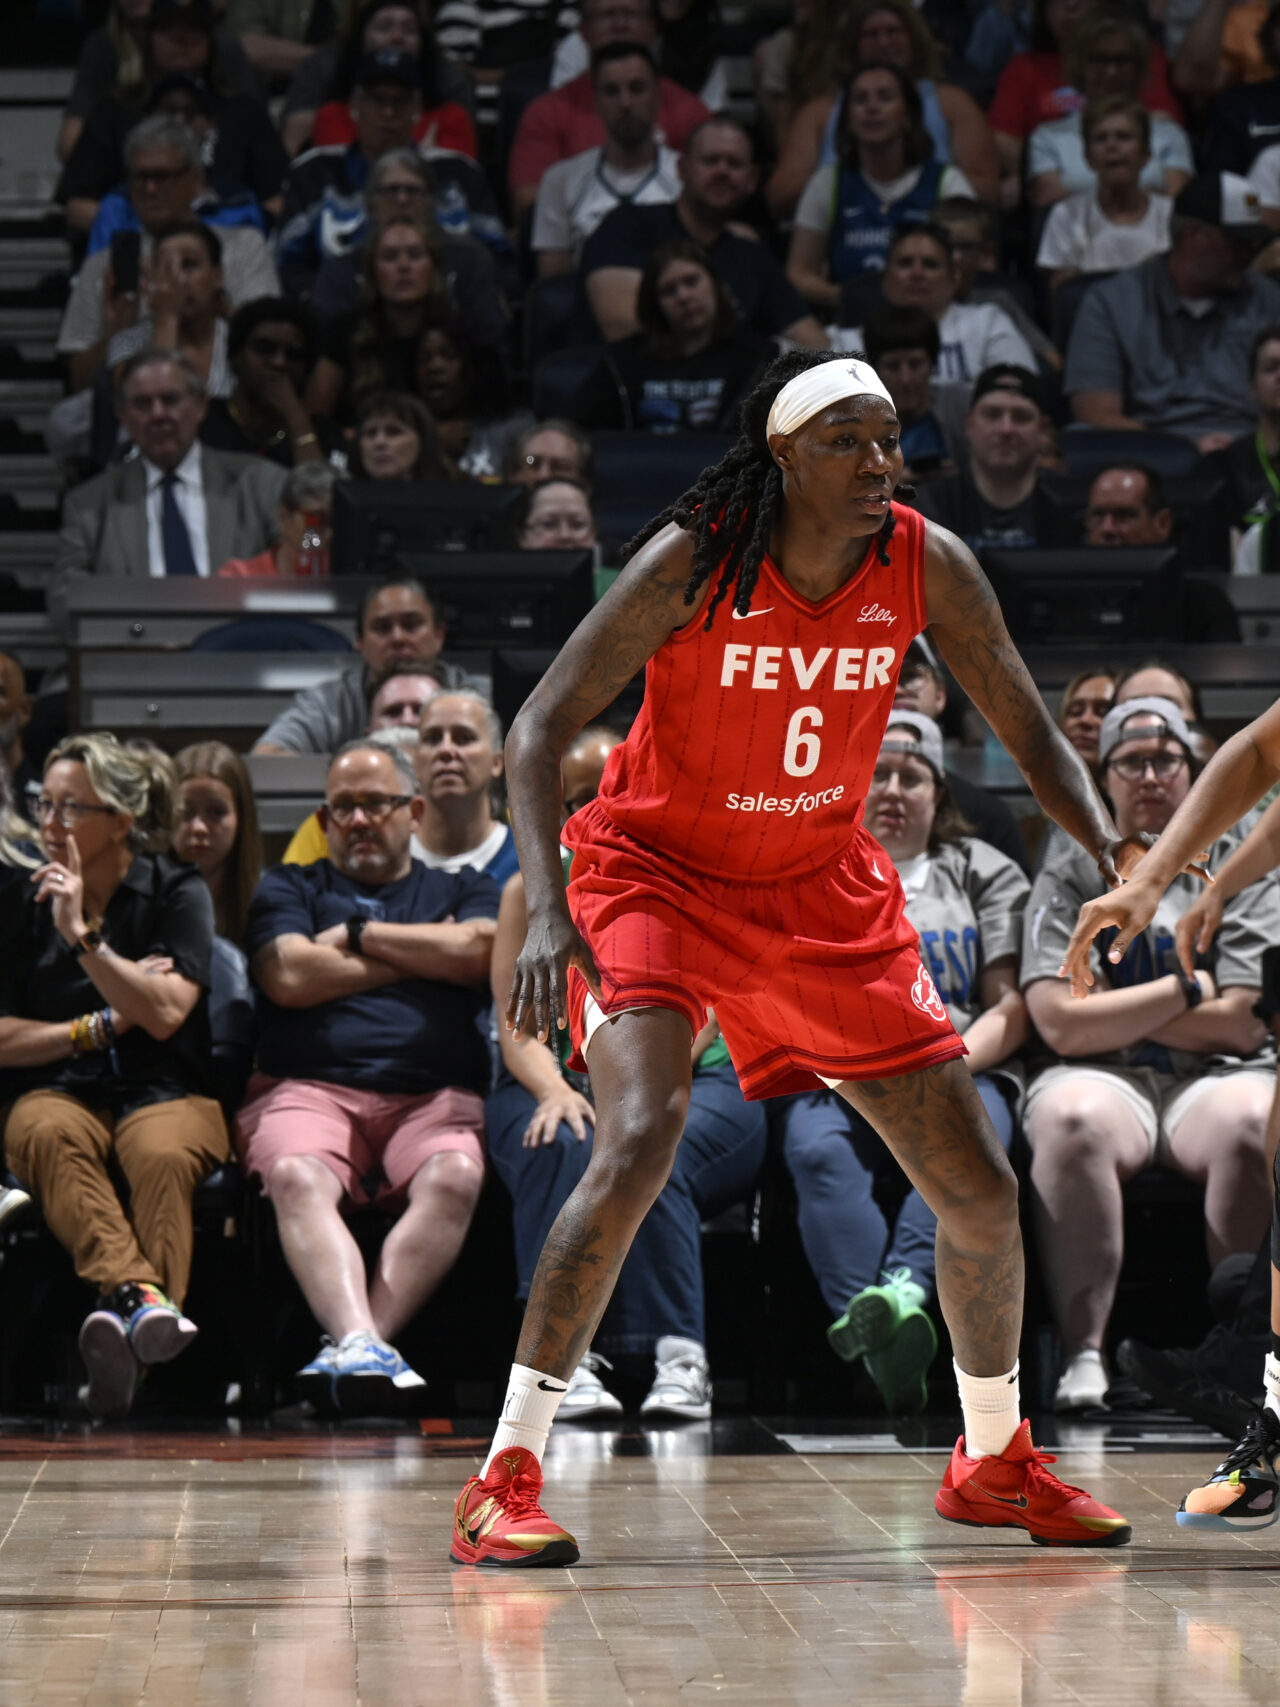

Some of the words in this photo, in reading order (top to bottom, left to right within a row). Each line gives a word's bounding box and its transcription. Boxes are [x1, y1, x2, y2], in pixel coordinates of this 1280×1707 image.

[857, 603, 897, 627] Lilly
[720, 643, 896, 690] FEVER
[783, 706, 823, 777] 6
[725, 785, 844, 816] salesforce
